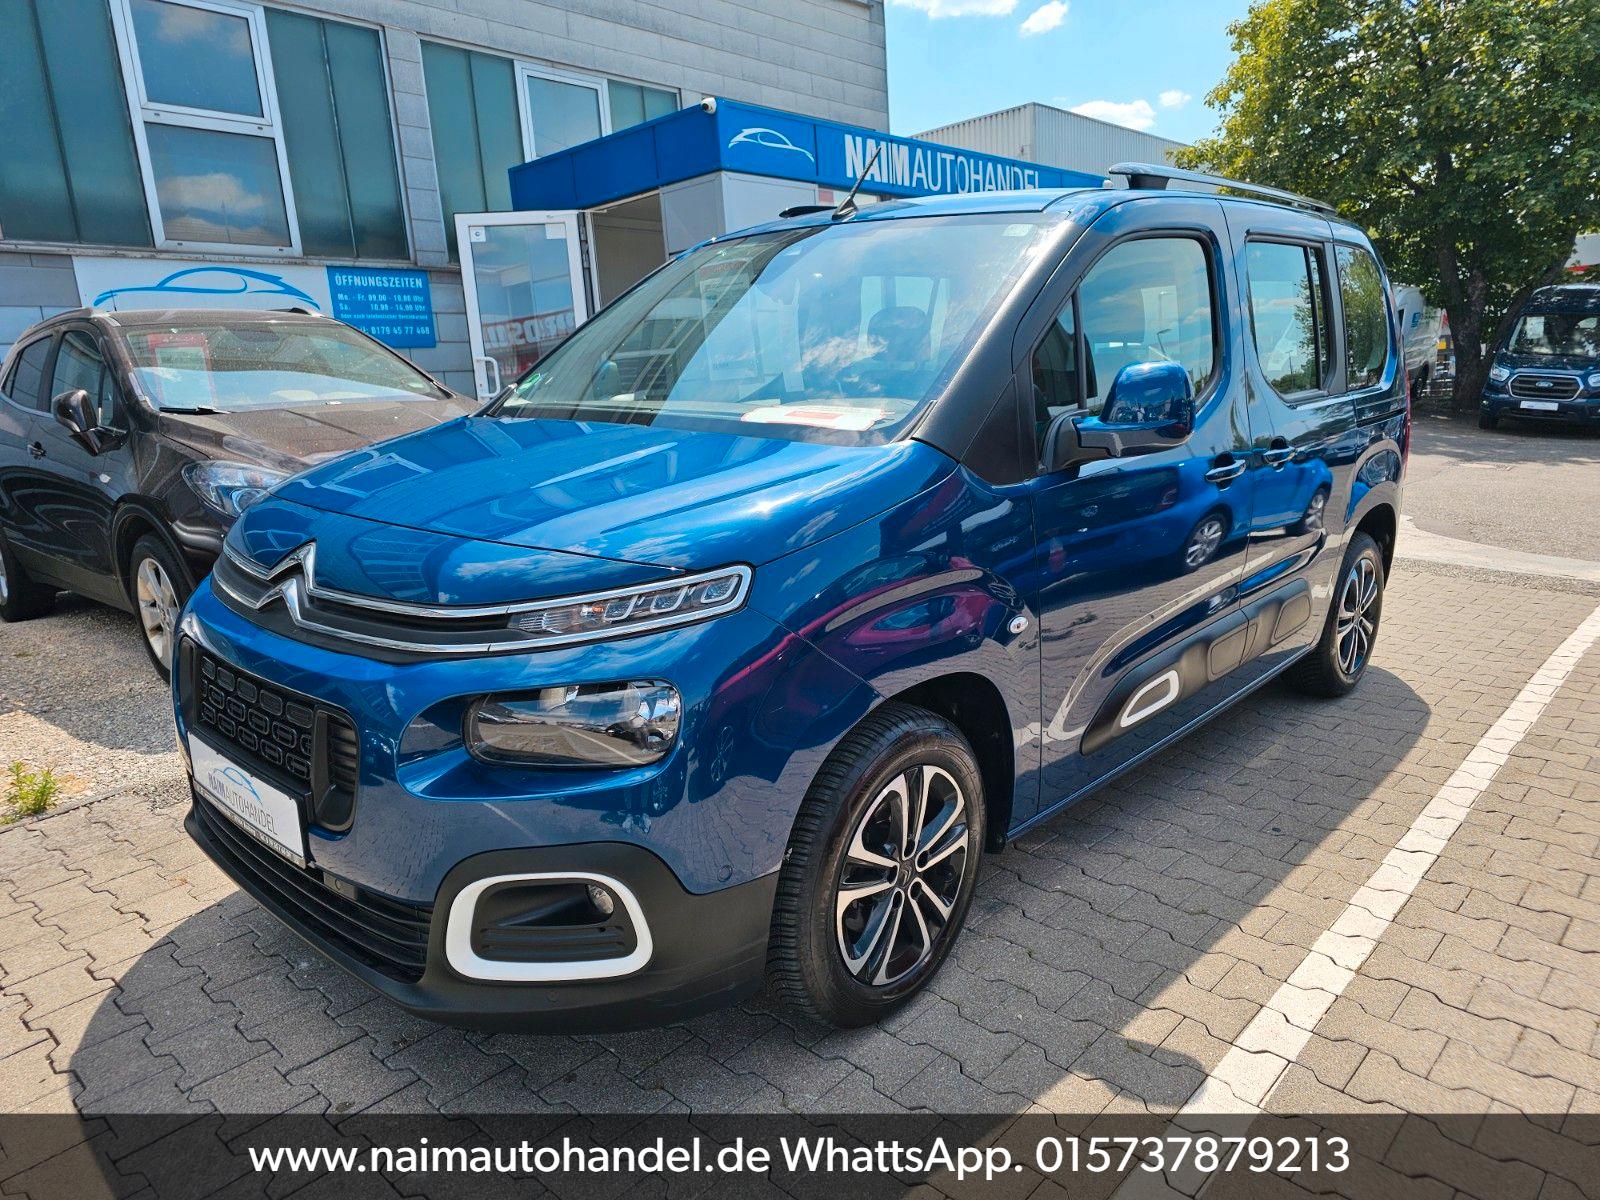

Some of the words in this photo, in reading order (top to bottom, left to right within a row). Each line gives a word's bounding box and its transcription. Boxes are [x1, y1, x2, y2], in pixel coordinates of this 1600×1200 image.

[335, 273, 423, 288] ÖFFNUNGSZEITEN
[370, 326, 390, 335] 0179
[392, 327, 402, 335] 45
[404, 327, 413, 335] 77
